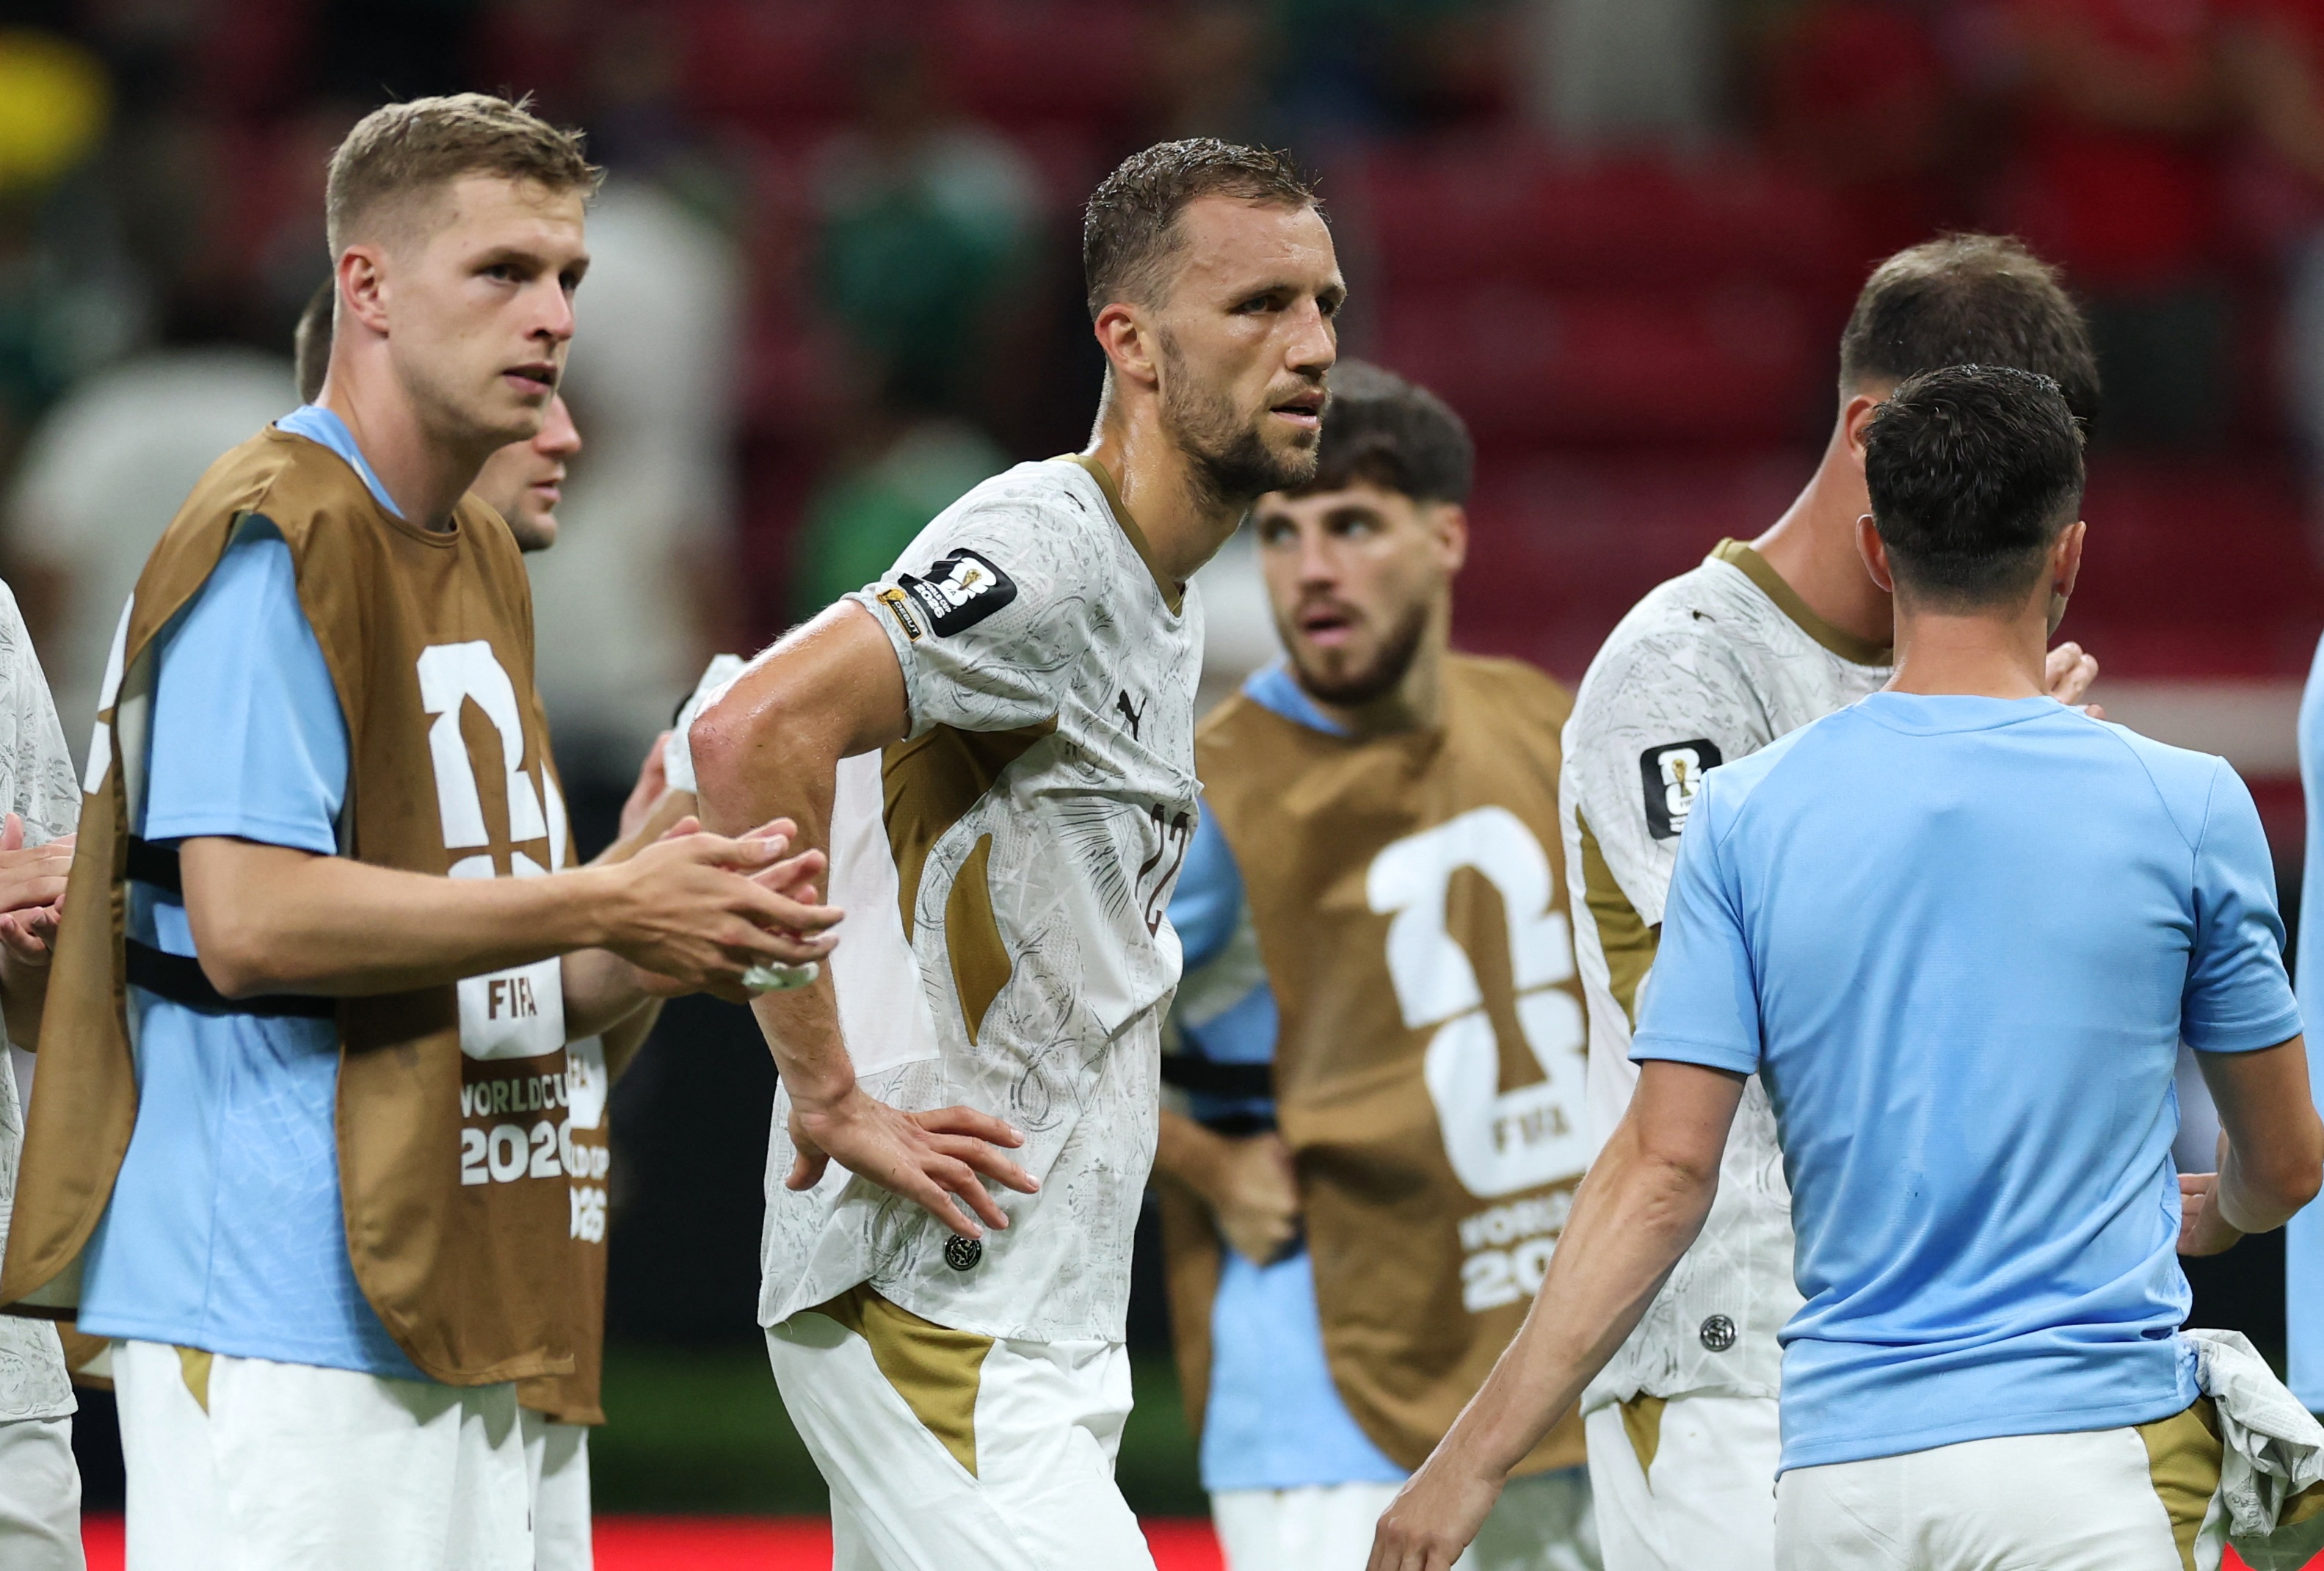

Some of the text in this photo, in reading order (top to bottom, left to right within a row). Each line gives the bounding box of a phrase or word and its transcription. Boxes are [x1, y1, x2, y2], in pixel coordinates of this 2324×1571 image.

[912, 584, 945, 619] 2026
[922, 581, 943, 601] WORLD
[940, 599, 951, 613] CUP
[893, 601, 920, 634] DEBUT
[489, 977, 537, 1020] FIFA
[570, 1186, 608, 1244] 26
[1459, 1237, 1556, 1313] 20
